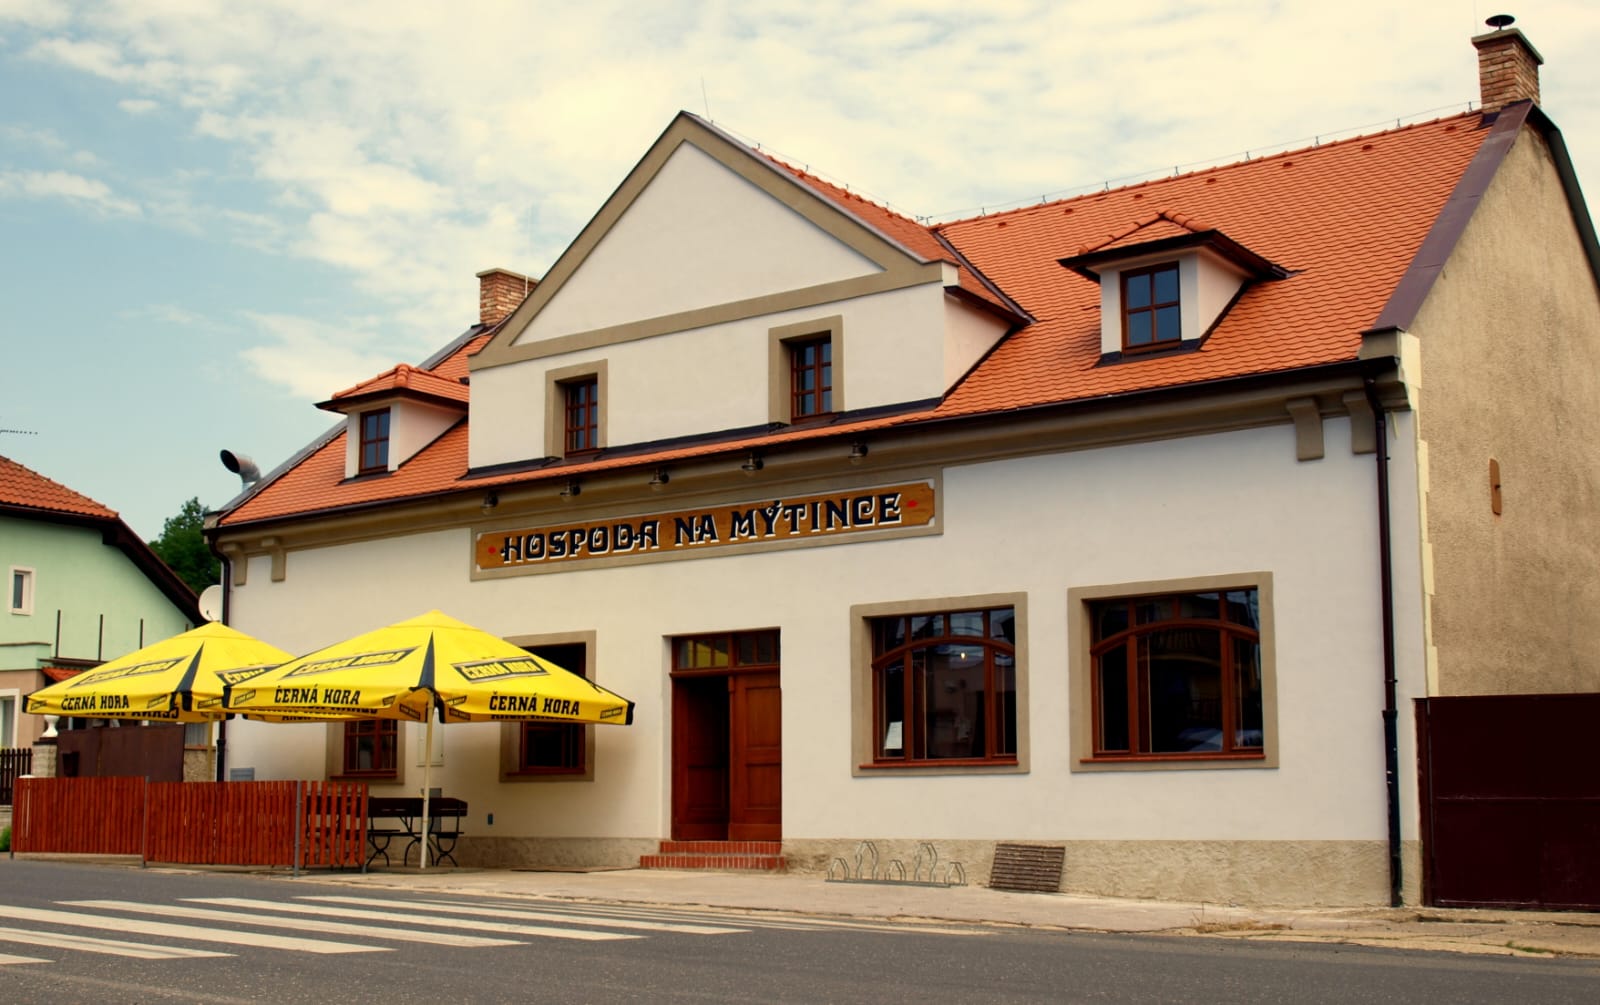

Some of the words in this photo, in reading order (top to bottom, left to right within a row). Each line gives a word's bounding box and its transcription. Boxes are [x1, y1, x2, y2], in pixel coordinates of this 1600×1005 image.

[501, 520, 660, 563] HOSPODA
[674, 513, 720, 546] NA
[729, 493, 902, 540] MÝTINCE
[61, 691, 96, 710] ČERNÁ
[100, 695, 129, 709] HORA
[273, 684, 318, 704] ČERNÁ
[323, 688, 361, 705] HORA
[489, 690, 537, 711] ČERNÁ
[543, 697, 580, 715] HORA
